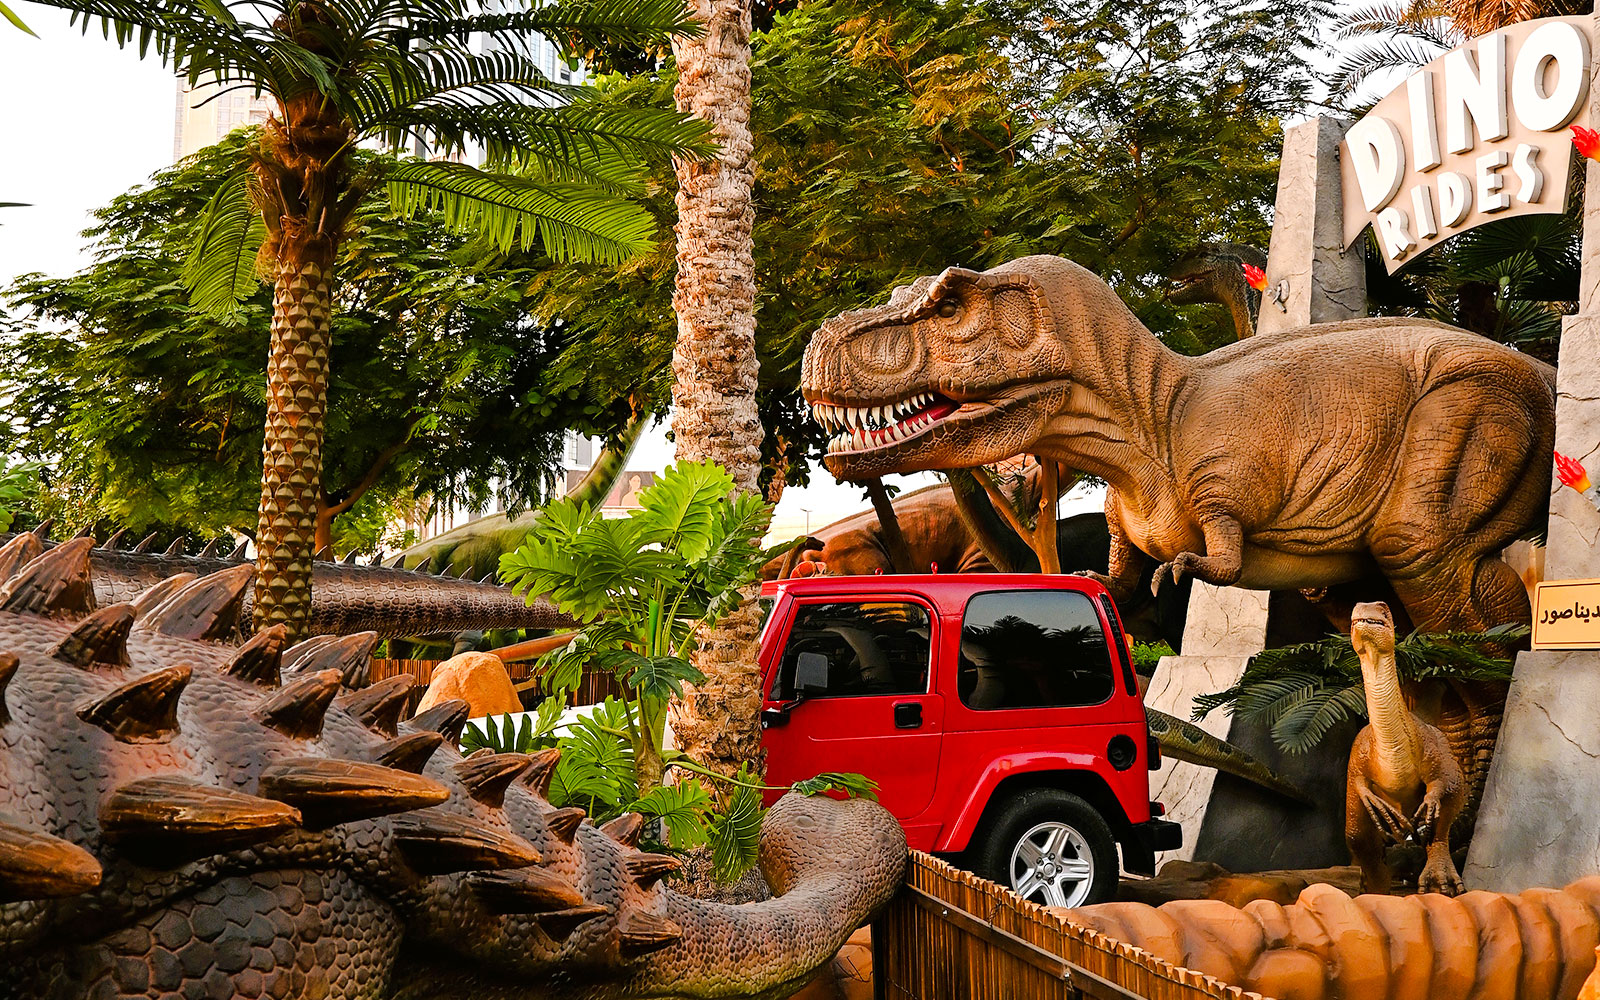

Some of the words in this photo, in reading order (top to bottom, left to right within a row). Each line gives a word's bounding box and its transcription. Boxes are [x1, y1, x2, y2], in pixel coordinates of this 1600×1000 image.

[1345, 21, 1590, 213] DINO
[1377, 143, 1543, 261] RIDES
[1540, 601, 1600, 625] ديناصور
